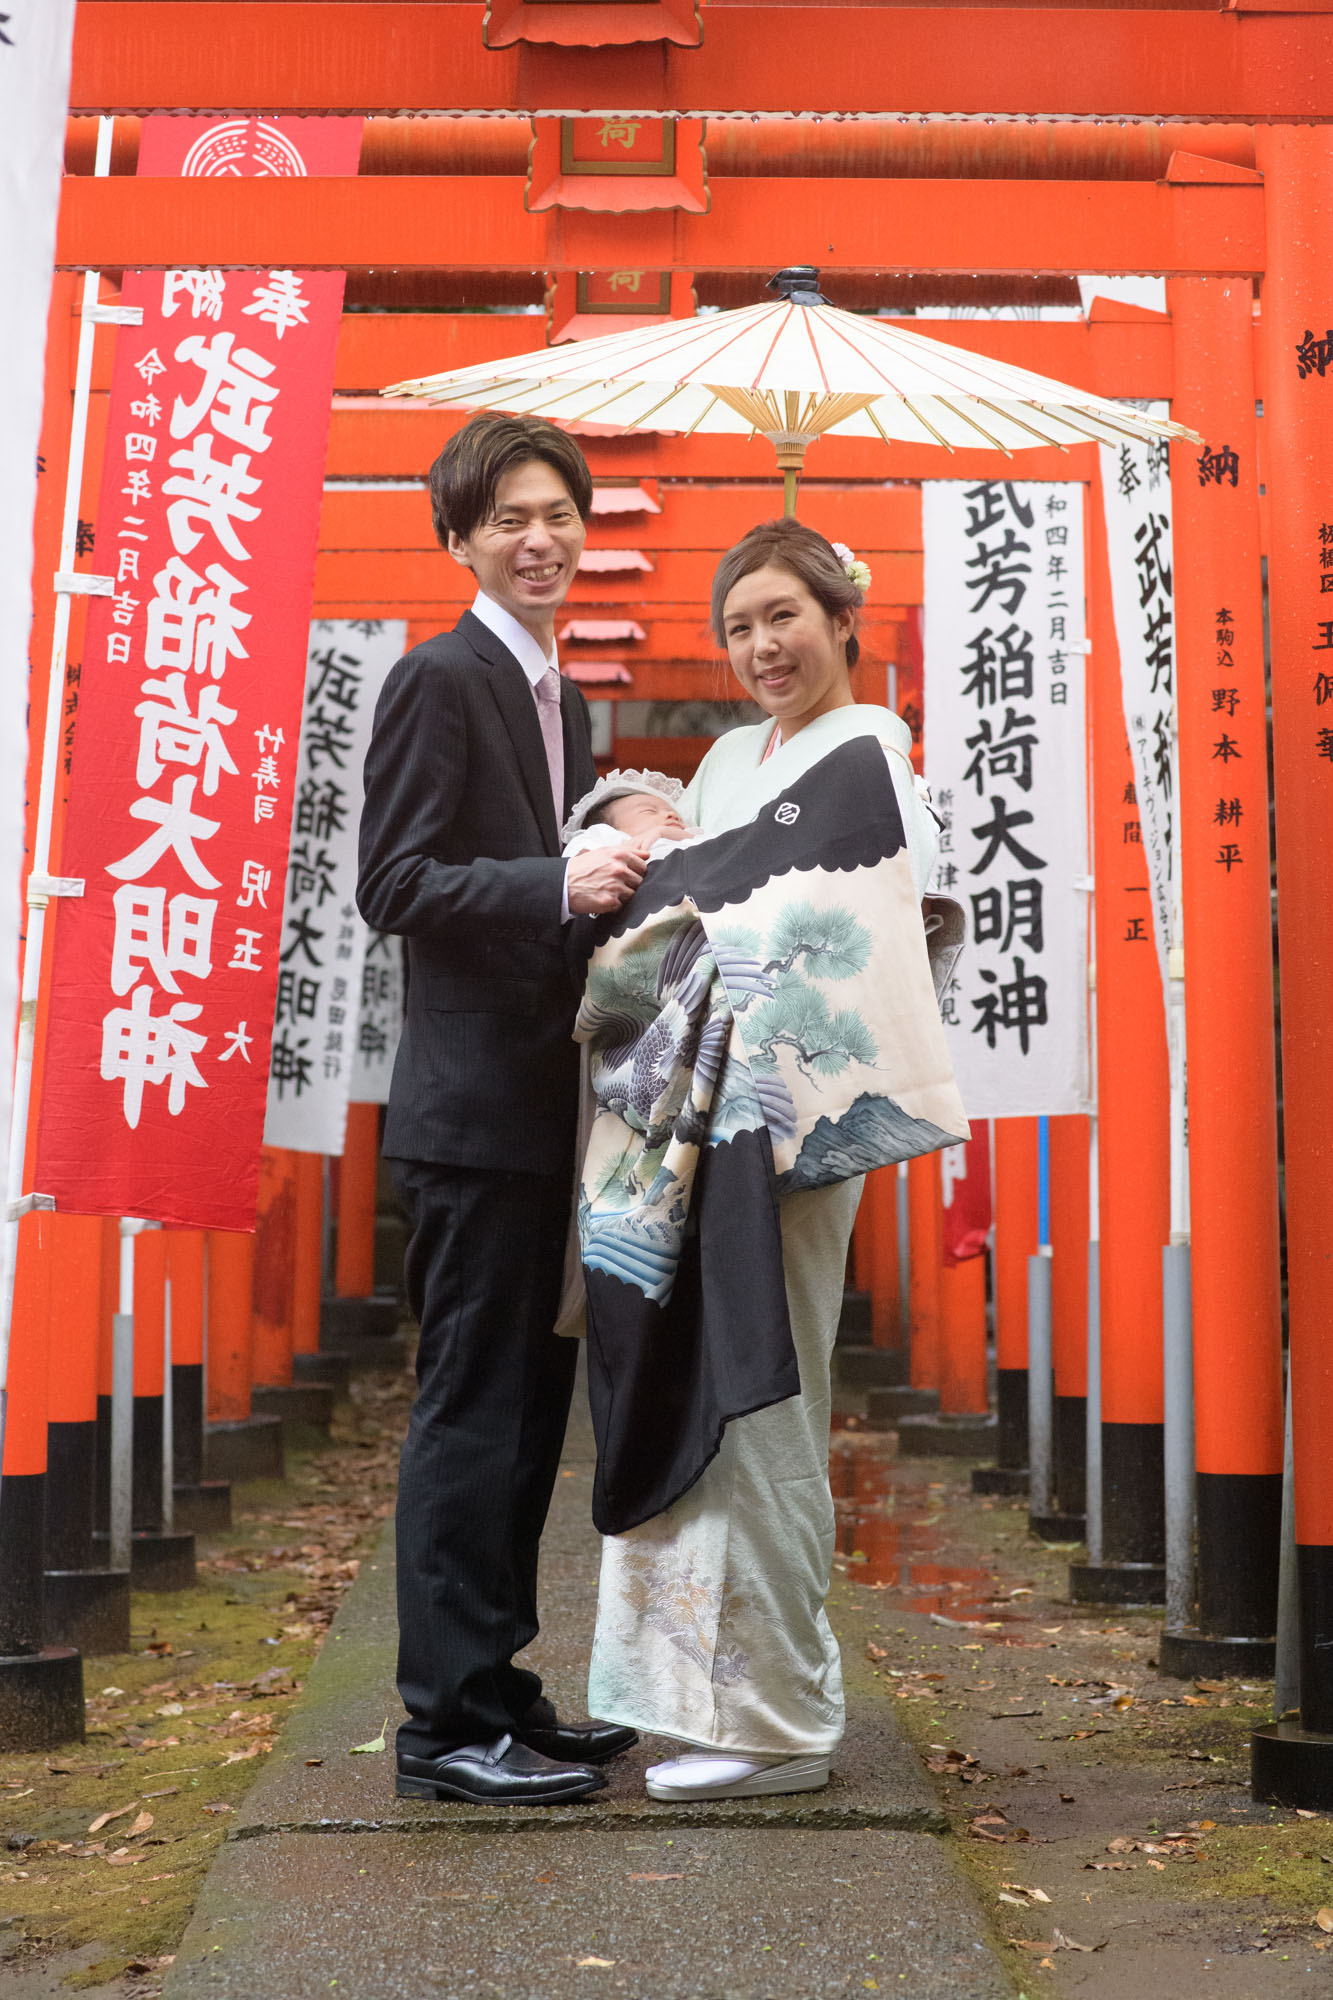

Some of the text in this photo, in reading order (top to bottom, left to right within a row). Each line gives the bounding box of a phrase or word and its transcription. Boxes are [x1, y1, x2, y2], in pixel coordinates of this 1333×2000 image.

[1197, 444, 1240, 488] 納
[1045, 492, 1069, 706] 和四年二月吉日
[960, 482, 1049, 1056] 武芳稲荷大明神
[1211, 607, 1244, 873] 本駒込 野本 耕平
